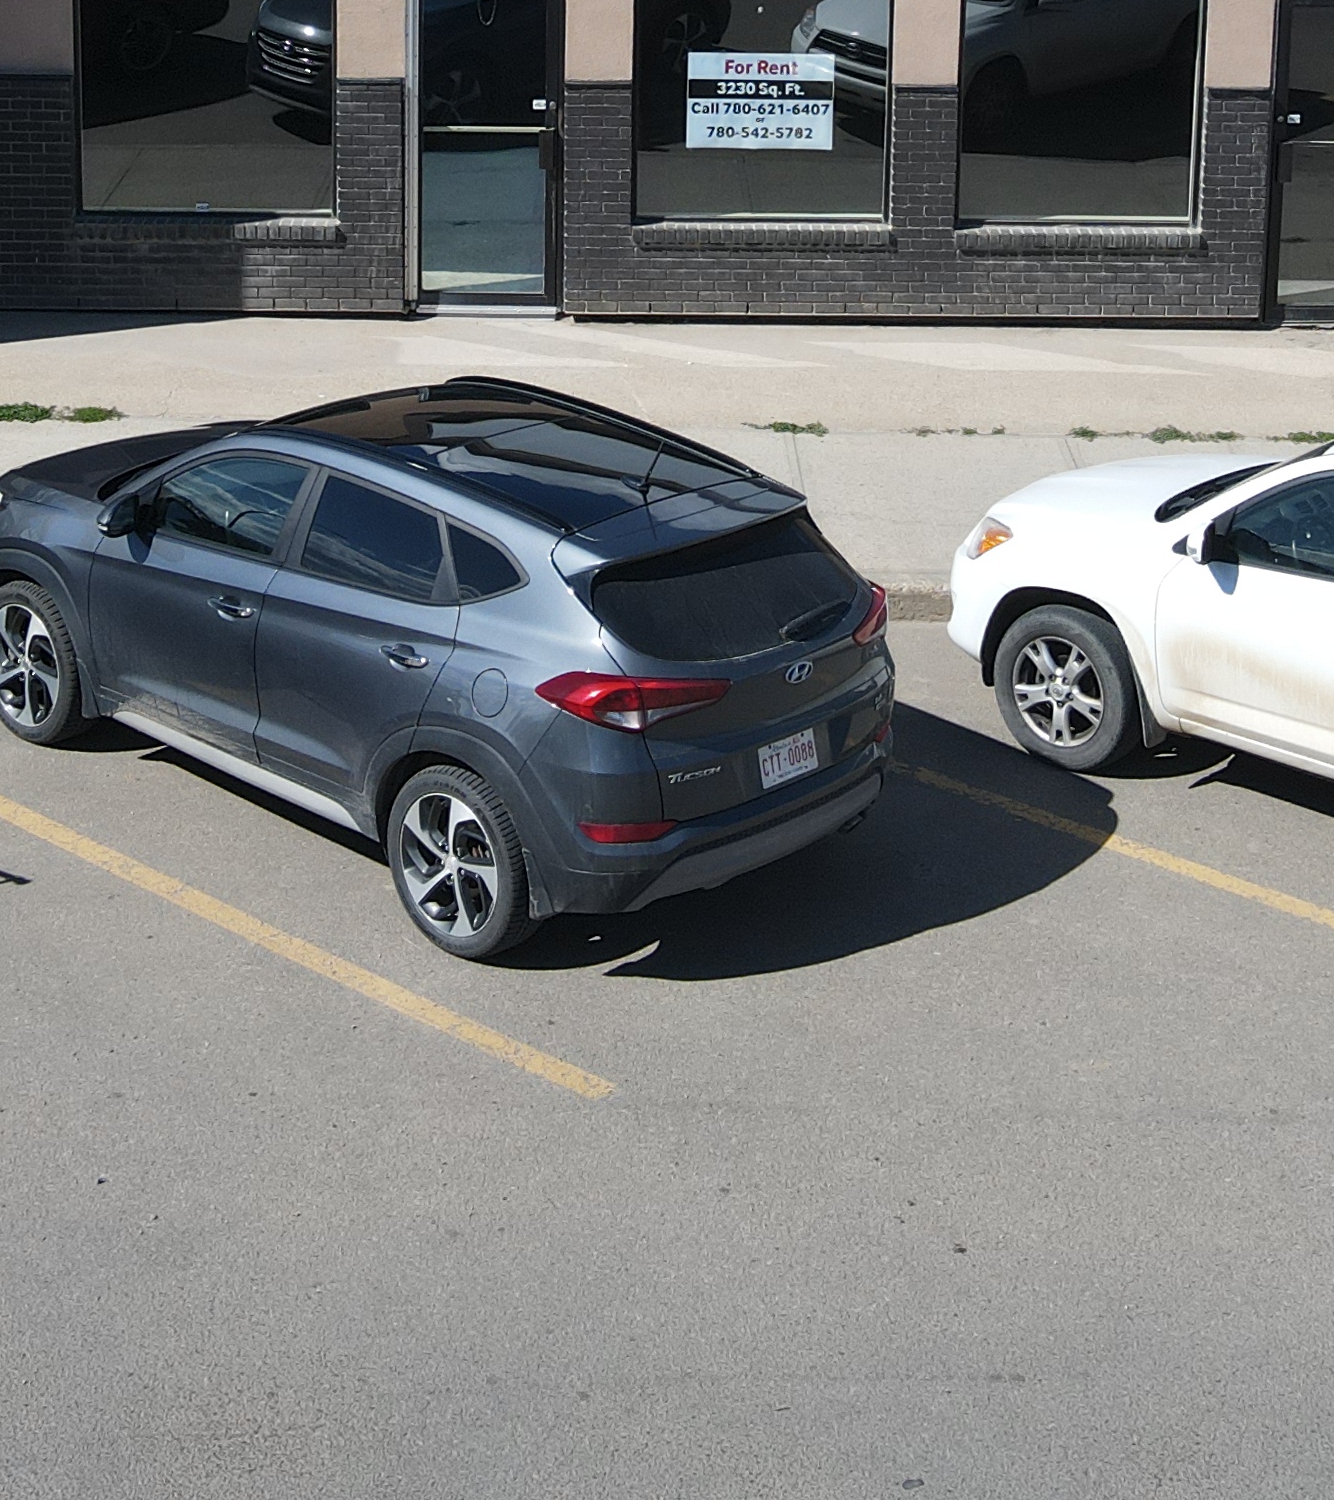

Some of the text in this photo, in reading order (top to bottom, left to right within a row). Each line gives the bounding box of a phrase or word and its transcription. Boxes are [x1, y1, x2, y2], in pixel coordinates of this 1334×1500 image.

[724, 59, 799, 76] For Rent
[717, 81, 805, 98] 3230 Sq. Ft.
[691, 102, 830, 116] Call 780-621-6407
